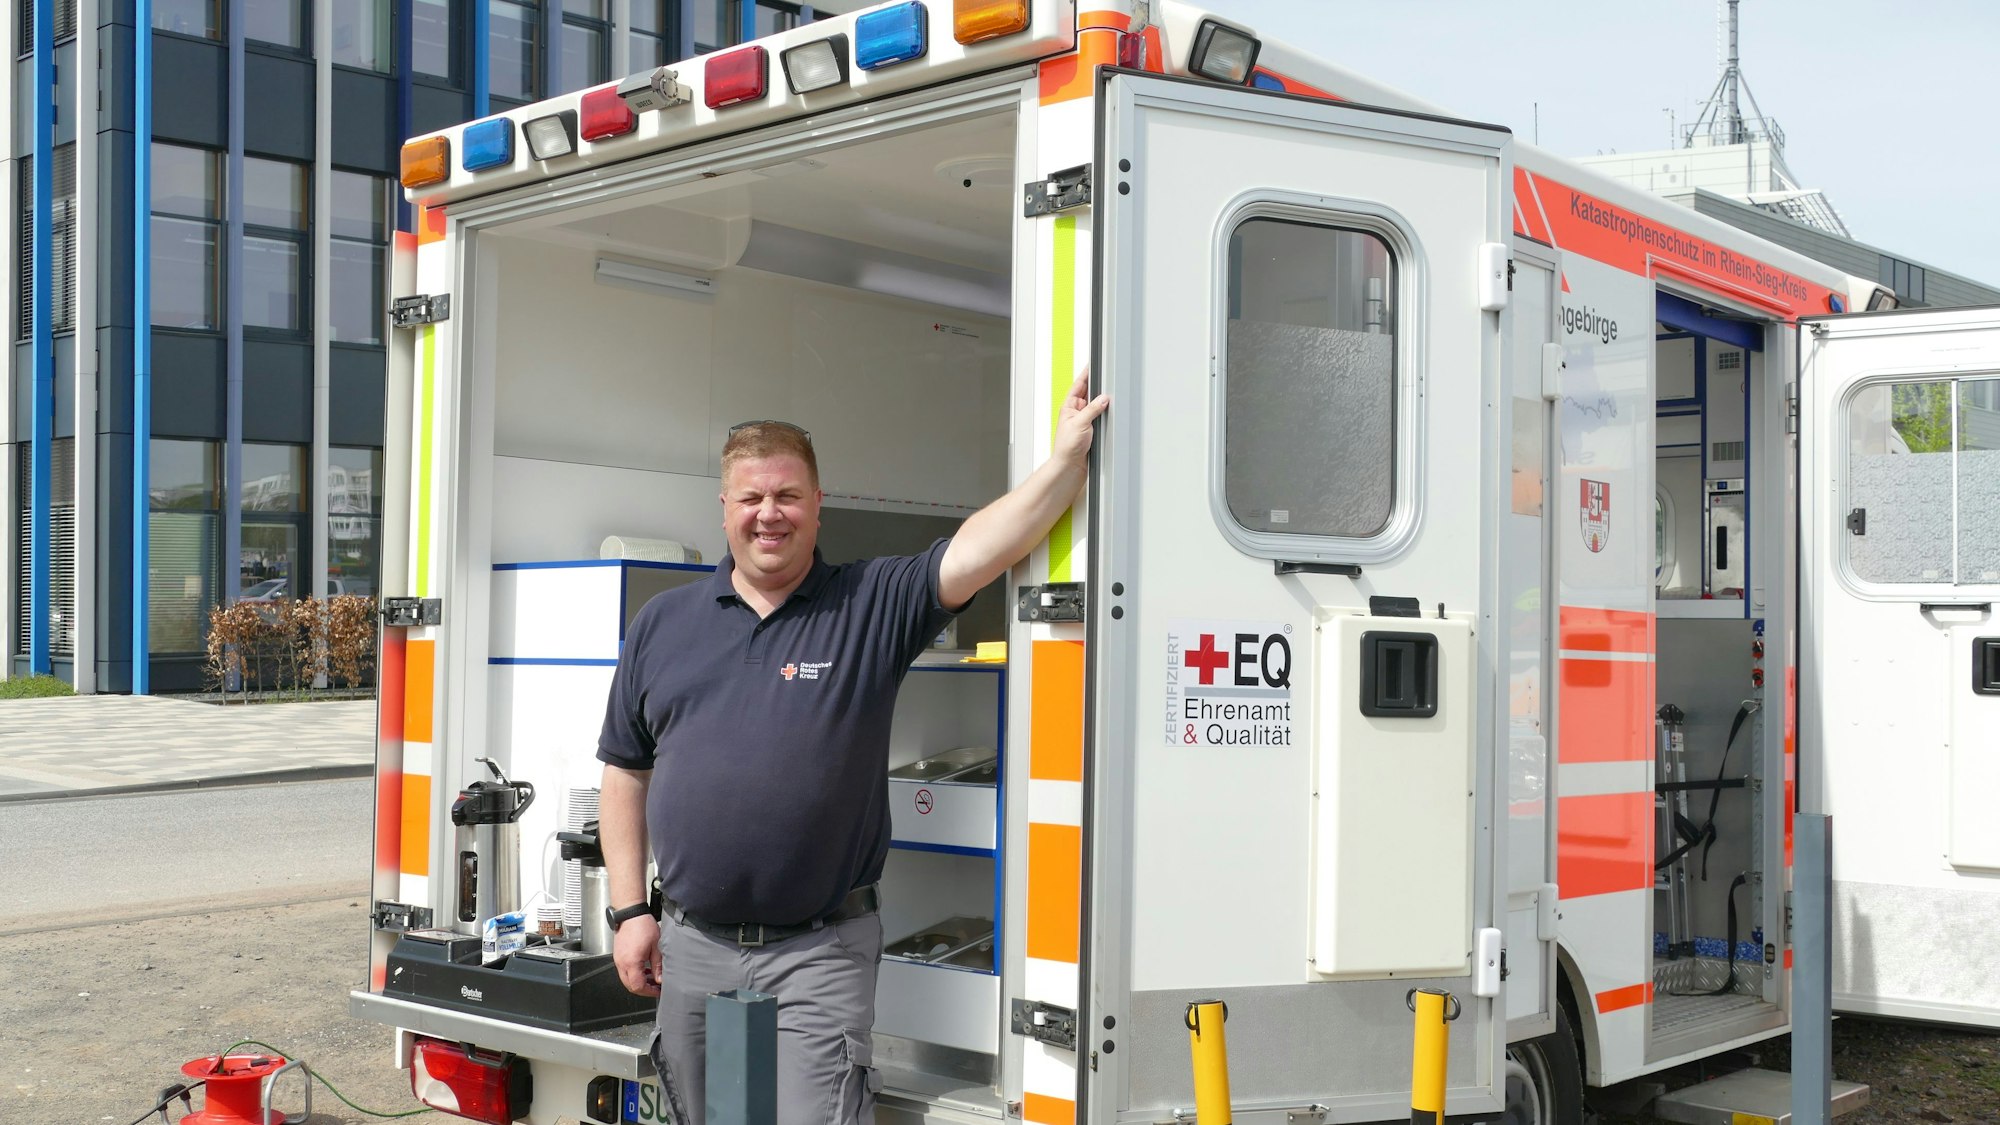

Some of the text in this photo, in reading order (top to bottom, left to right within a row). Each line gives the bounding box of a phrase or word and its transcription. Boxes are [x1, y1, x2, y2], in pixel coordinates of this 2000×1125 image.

[1571, 192, 1808, 302] Katastrophenschutz im Rhein-Sieg-Kreis
[800, 661, 832, 669] Deutsches
[1165, 633, 1179, 744] ZERTIFIZIERT
[1184, 698, 1291, 721] Ehrenamt
[1183, 723, 1291, 746] & Qualität
[629, 1101, 635, 1113] D
